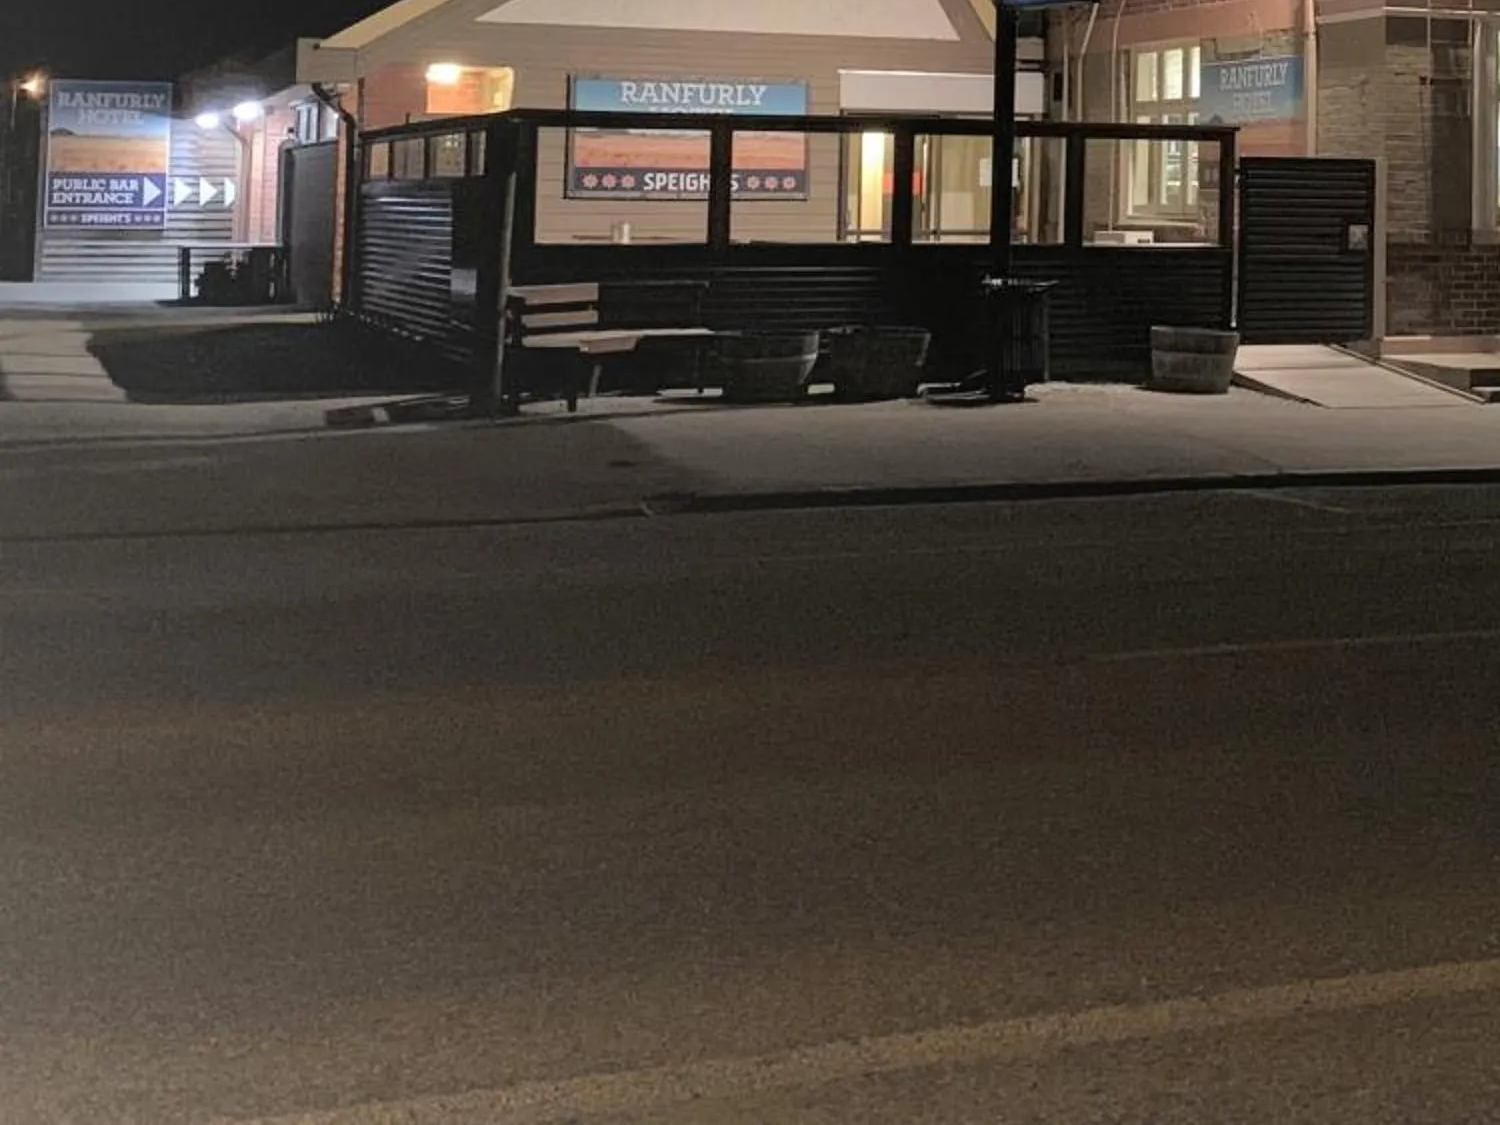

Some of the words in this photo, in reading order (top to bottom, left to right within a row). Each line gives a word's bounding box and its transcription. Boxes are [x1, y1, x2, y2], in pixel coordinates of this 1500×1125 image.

[1219, 61, 1289, 91] RANFURLY
[58, 91, 165, 108] RANFURLY
[620, 81, 768, 105] RANFURLY
[78, 108, 145, 125] HOTEL
[52, 178, 107, 192] PUBLIC
[109, 178, 139, 192] BAR
[643, 172, 739, 191] SPEIGHS
[51, 192, 135, 204] ENTRANCE
